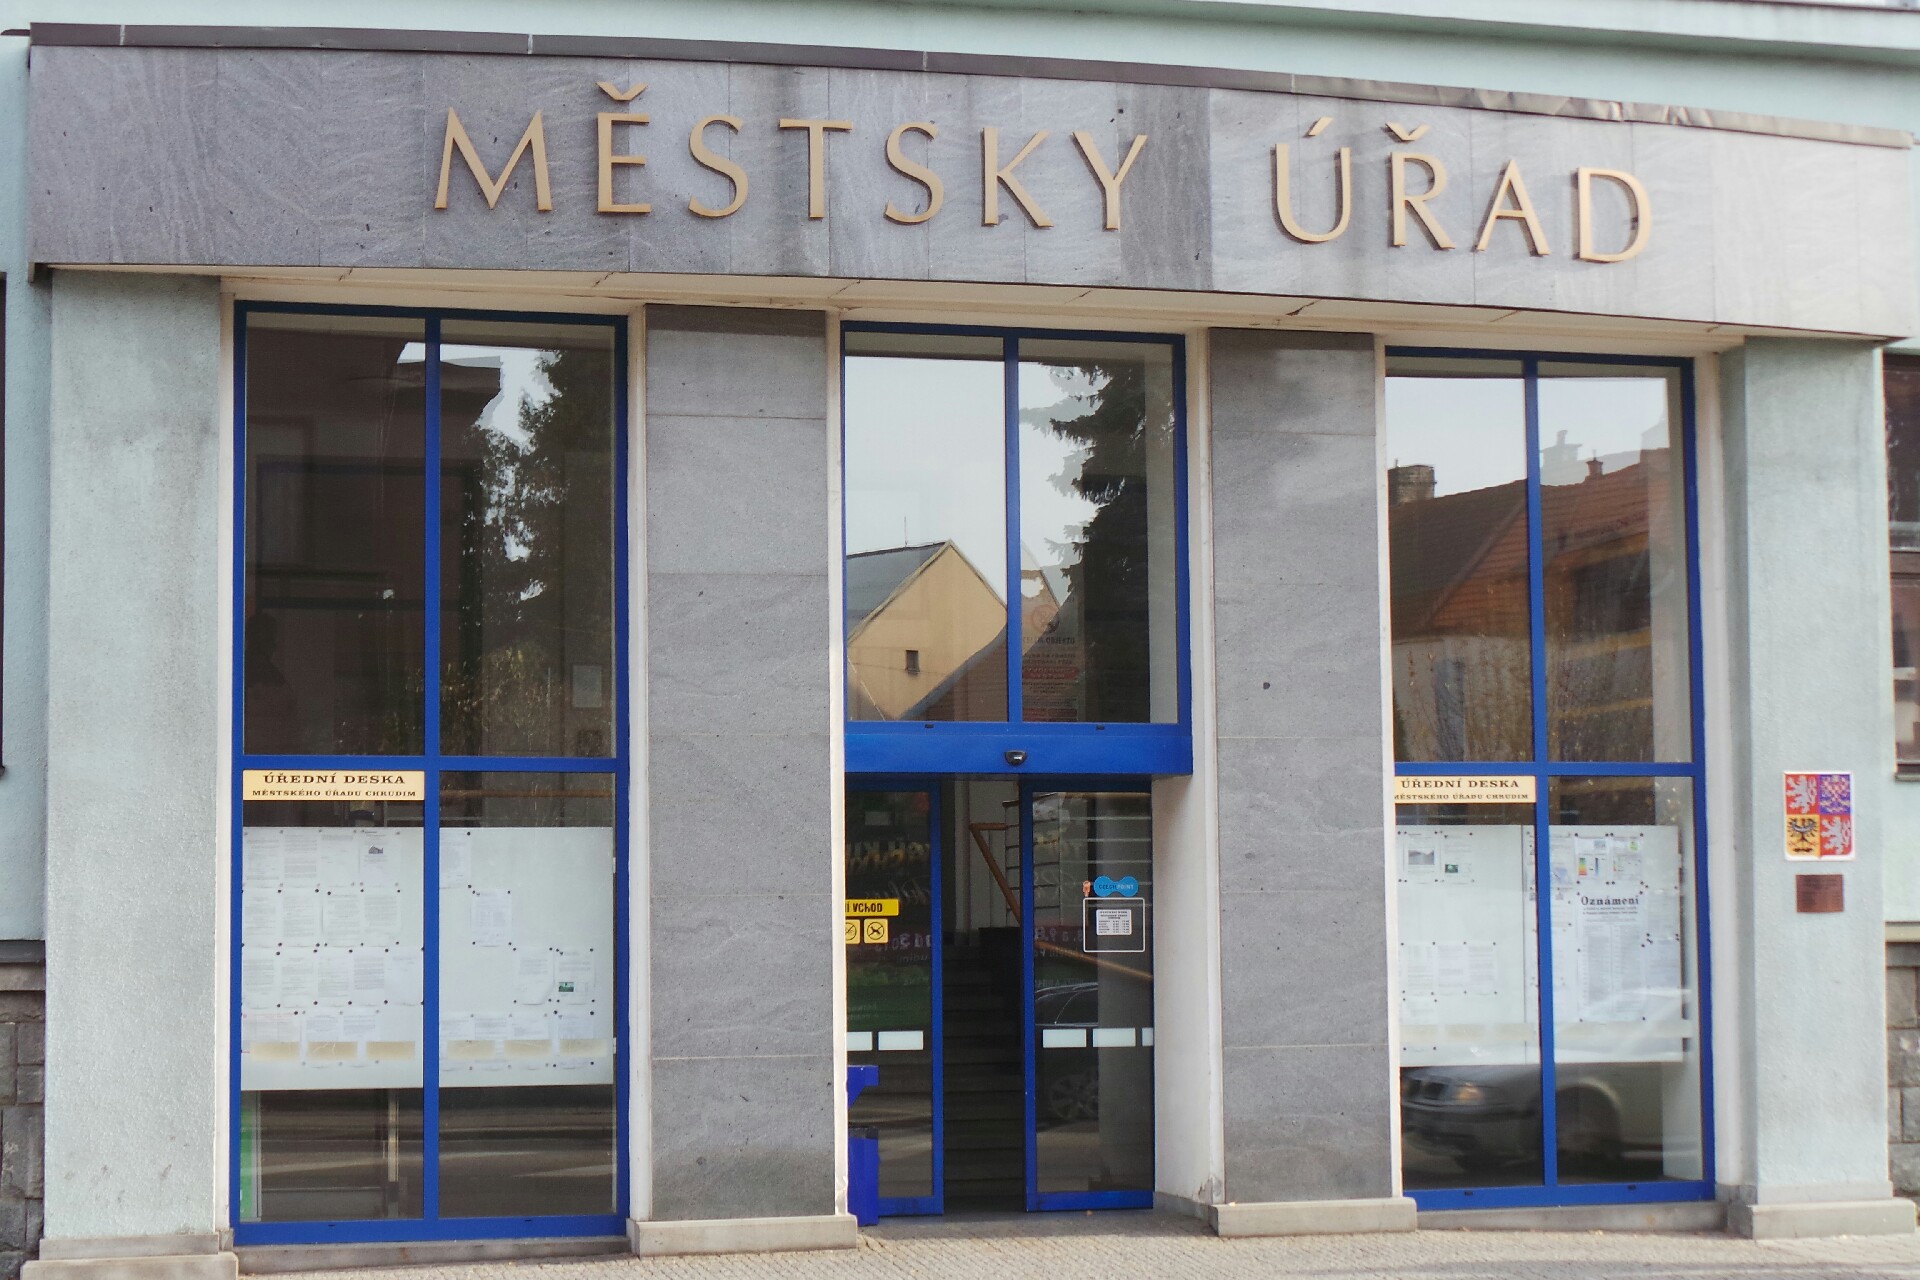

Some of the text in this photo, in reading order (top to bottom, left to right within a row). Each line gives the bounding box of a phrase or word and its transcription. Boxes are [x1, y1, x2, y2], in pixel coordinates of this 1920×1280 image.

[1275, 116, 1652, 264] ÚŘAD
[264, 772, 405, 784] ÚŘEDNÍ DESKA
[1401, 778, 1519, 789] ÚŘEDNÍ DESKA
